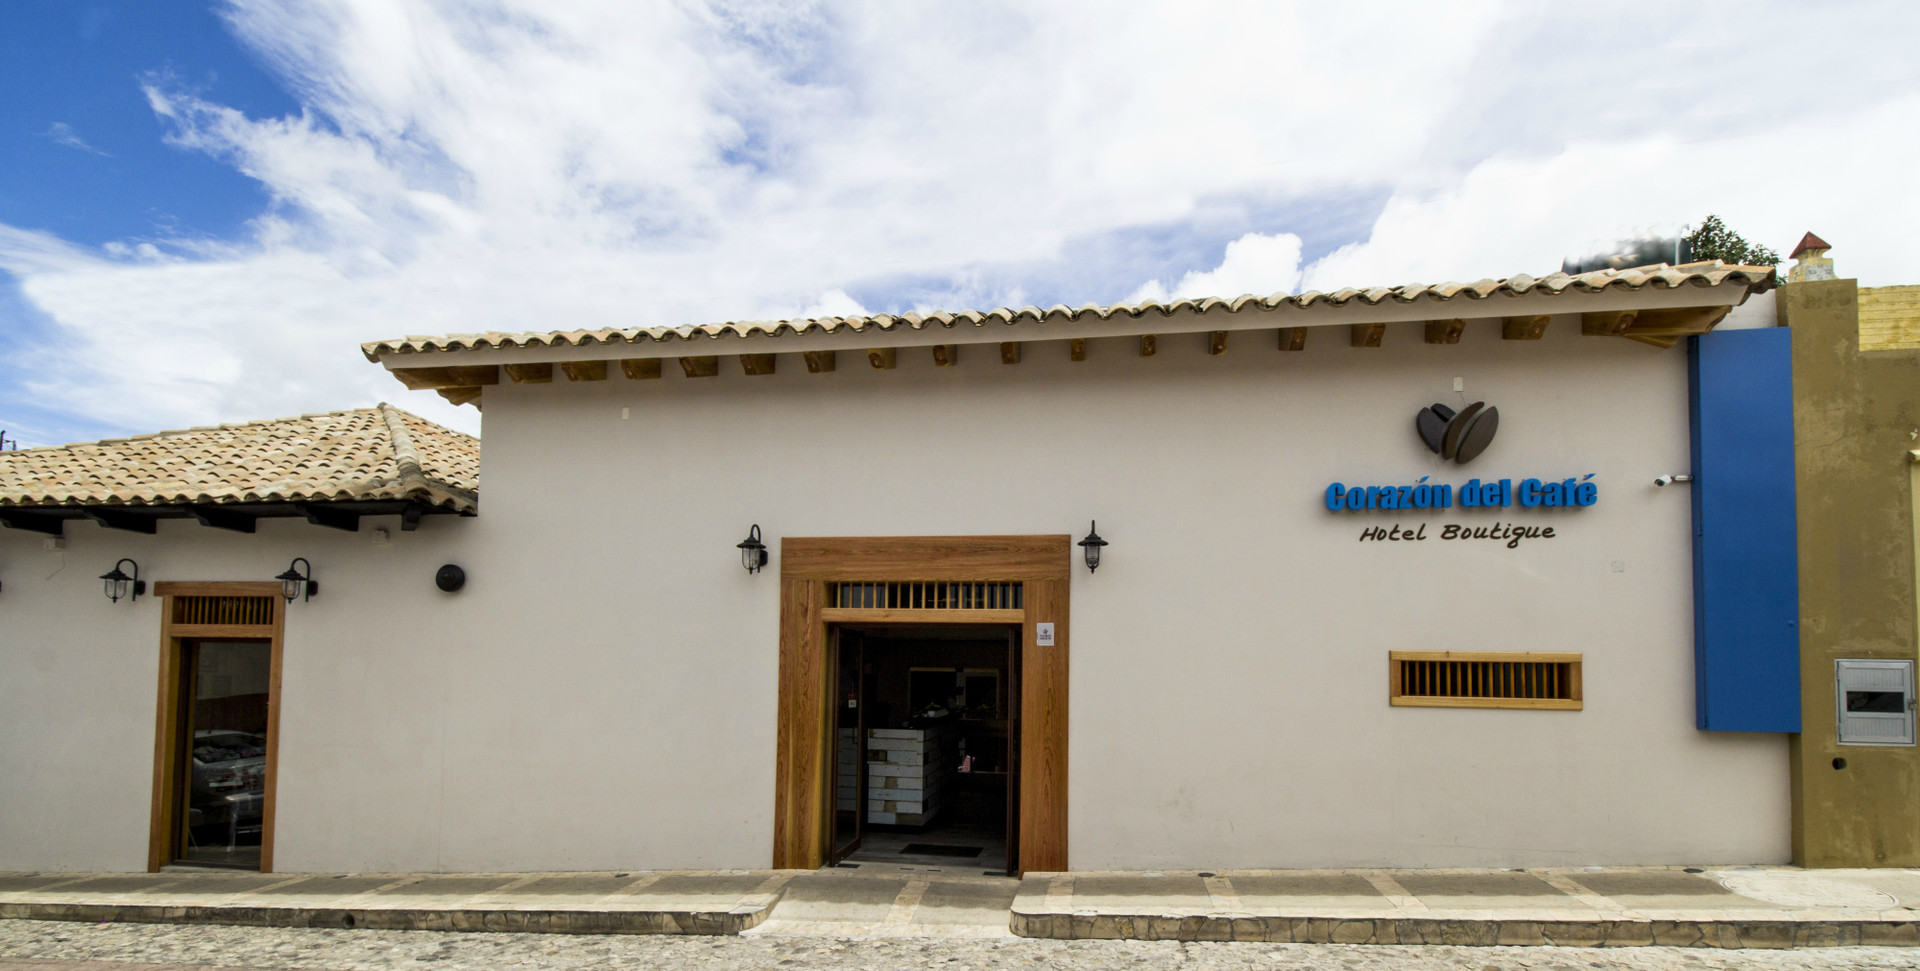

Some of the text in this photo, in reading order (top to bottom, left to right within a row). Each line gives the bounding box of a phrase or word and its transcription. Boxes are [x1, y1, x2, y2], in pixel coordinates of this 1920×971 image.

[1325, 473, 1597, 511] Corazón del Café
[1359, 522, 1556, 549] Hotel Boutique
